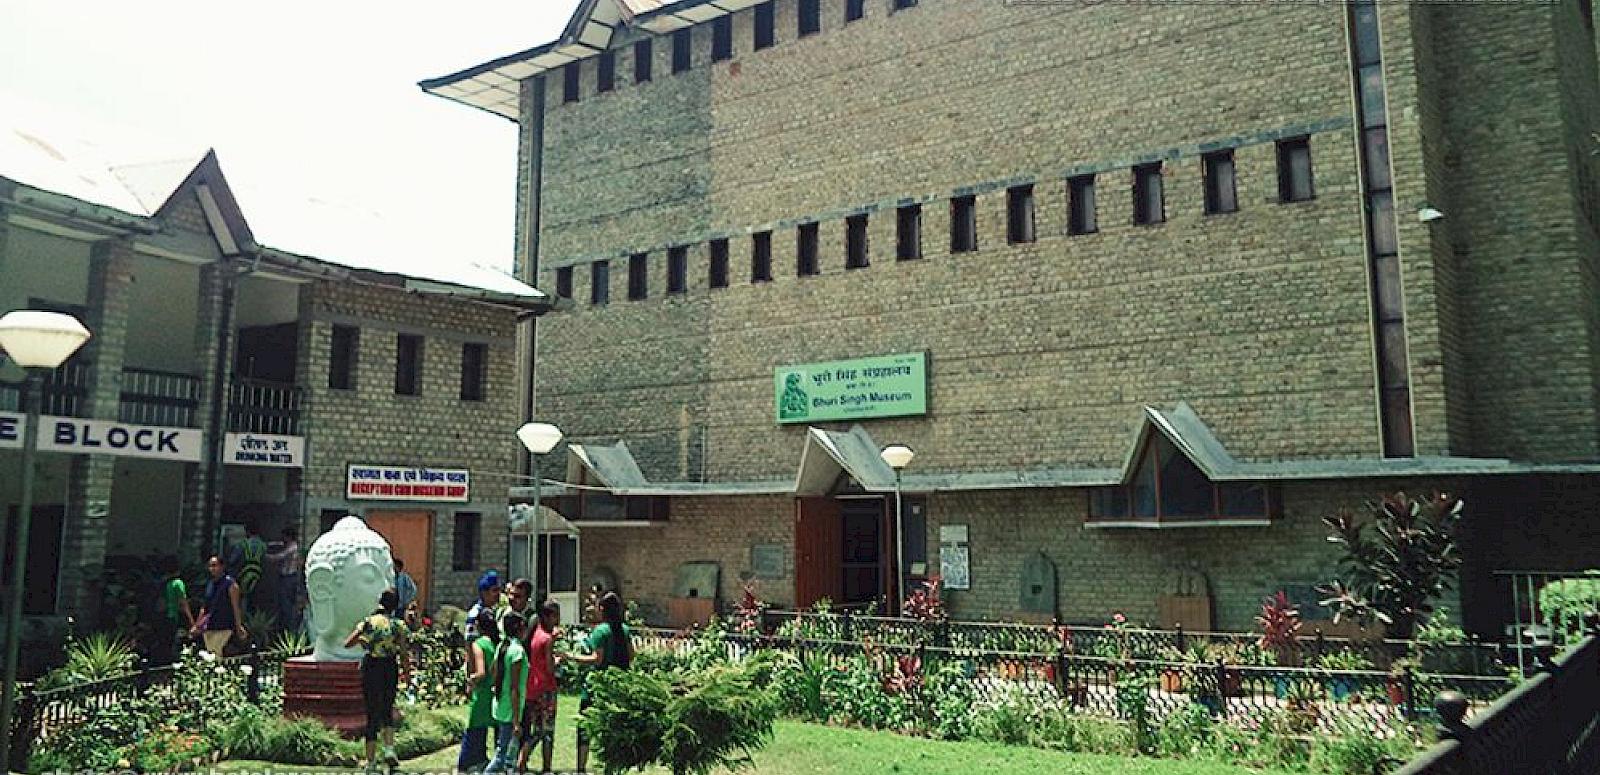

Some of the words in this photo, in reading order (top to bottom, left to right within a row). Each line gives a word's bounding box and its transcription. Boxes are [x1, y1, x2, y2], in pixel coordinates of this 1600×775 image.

[840, 394, 867, 406] Singh
[869, 391, 913, 403] Museum
[54, 422, 180, 453] BLOCK
[351, 483, 393, 495] RECEPTION
